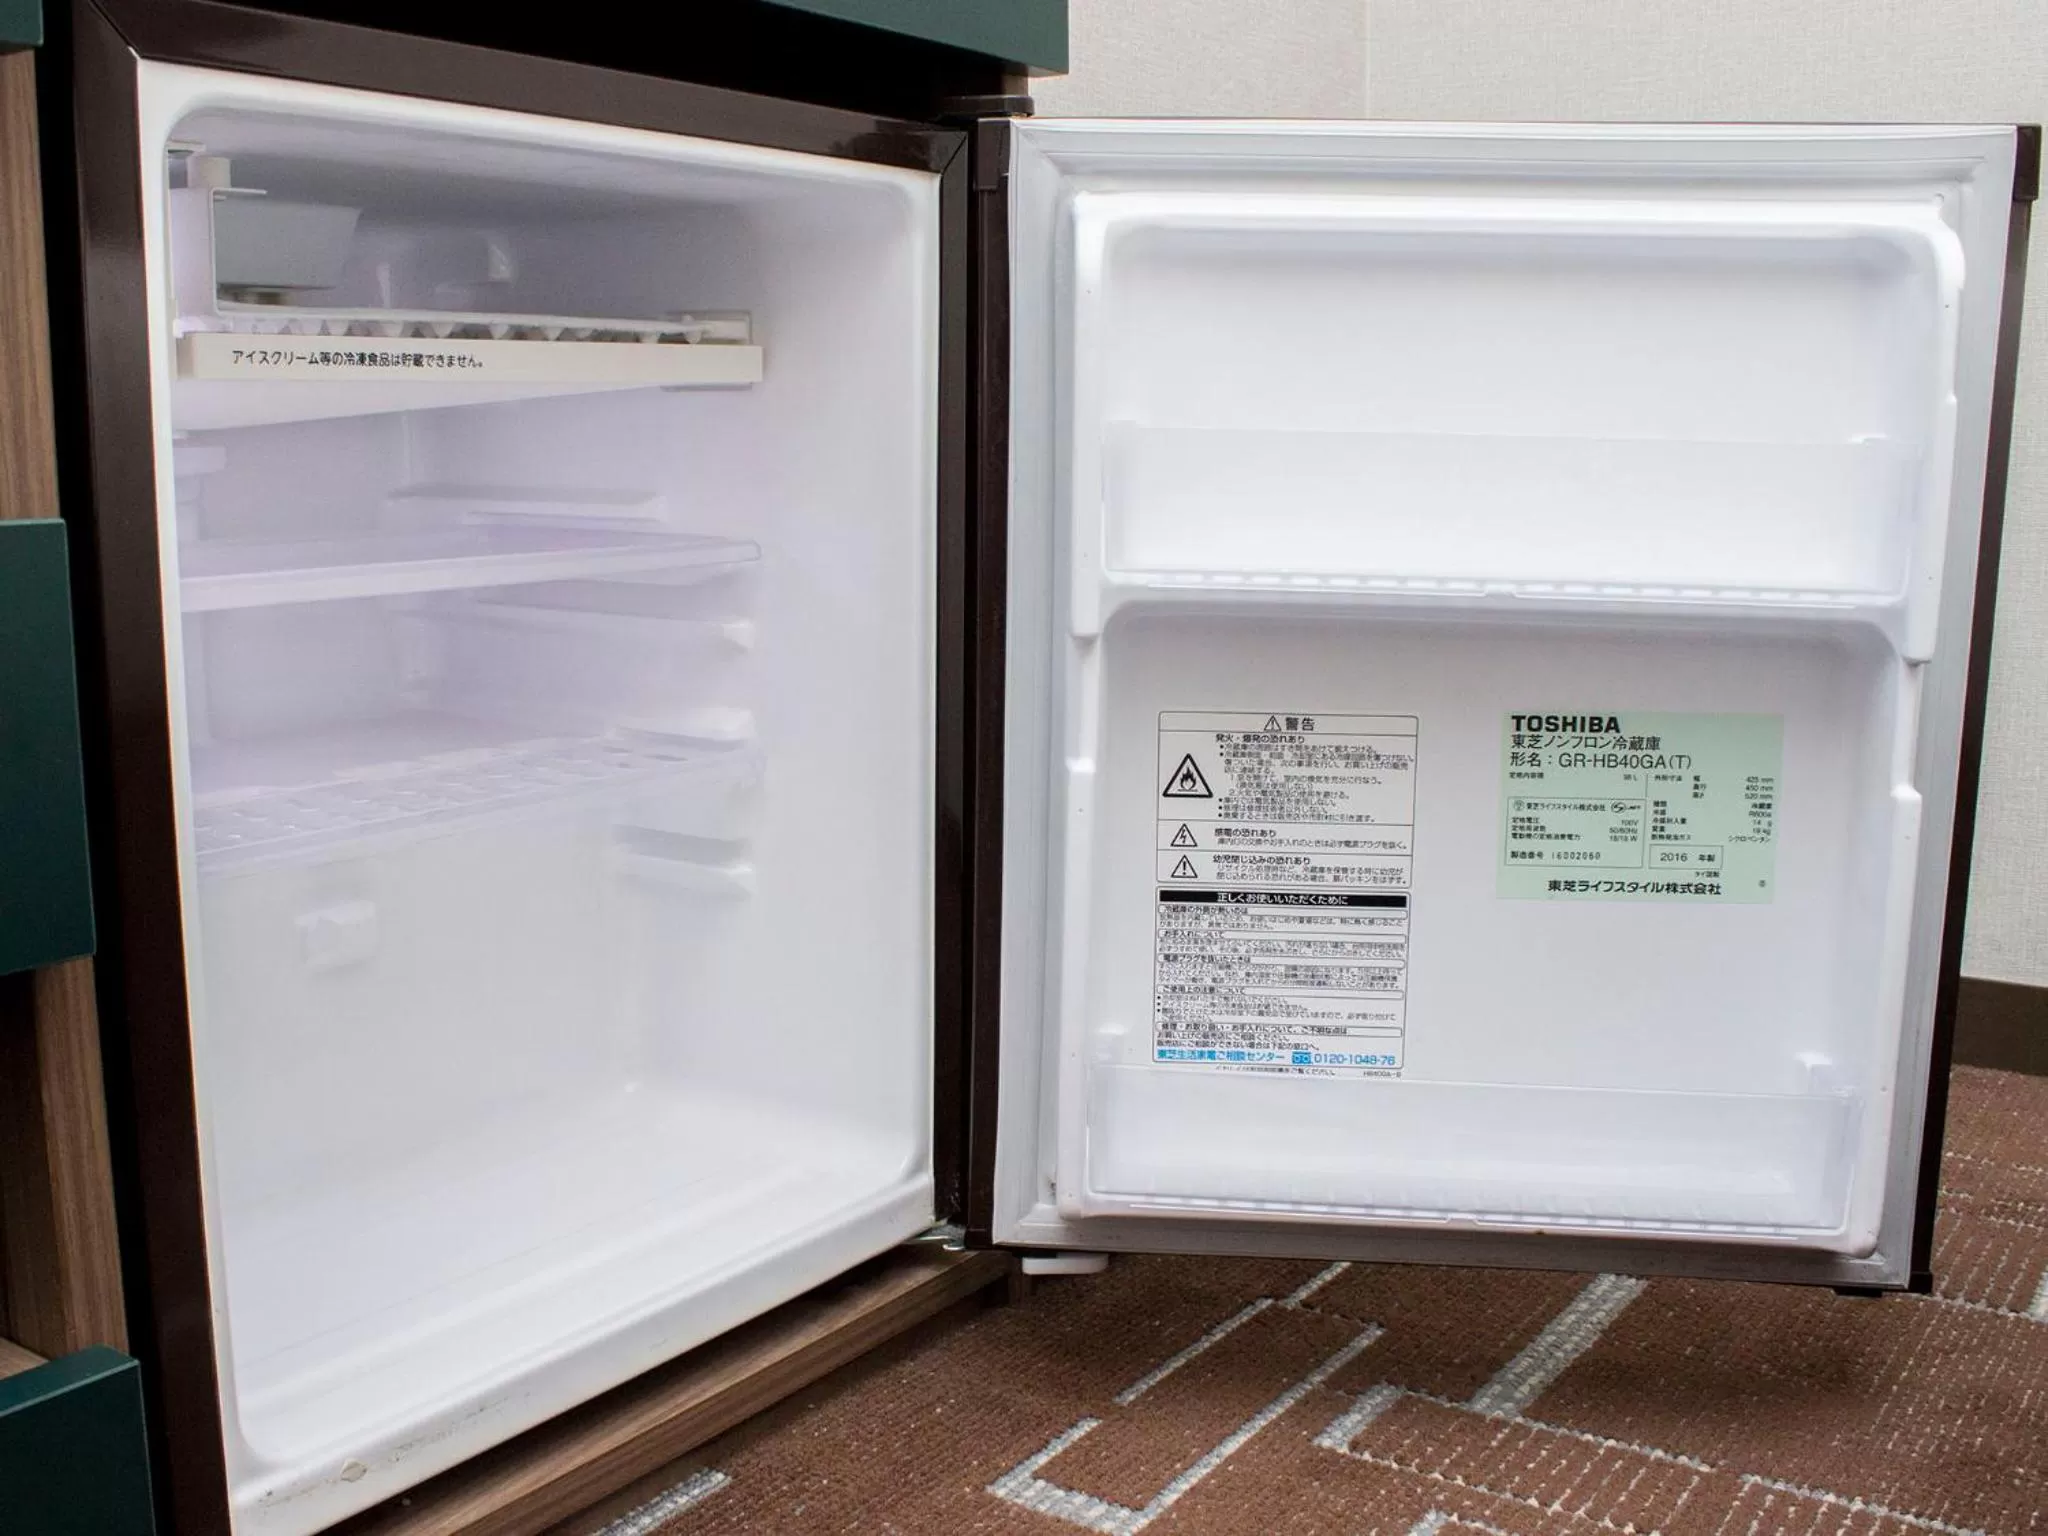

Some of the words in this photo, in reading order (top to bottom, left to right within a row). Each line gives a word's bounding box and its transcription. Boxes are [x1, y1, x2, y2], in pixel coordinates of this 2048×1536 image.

[232, 349, 484, 368] アイスクリーム等の冷凍食品は貯蔵できません。
[1285, 717, 1315, 731] 警告
[1511, 715, 1620, 733] TOSHIBA
[1511, 735, 1660, 751] 東芝ノンフロン冷蔵庫
[1660, 852, 1688, 862] 2016
[1547, 880, 1722, 896] 東芝ライフスタイル株式会社
[1217, 892, 1348, 906] 正しくお使いいただくために
[1314, 1053, 1396, 1066] 0120-1048-76
